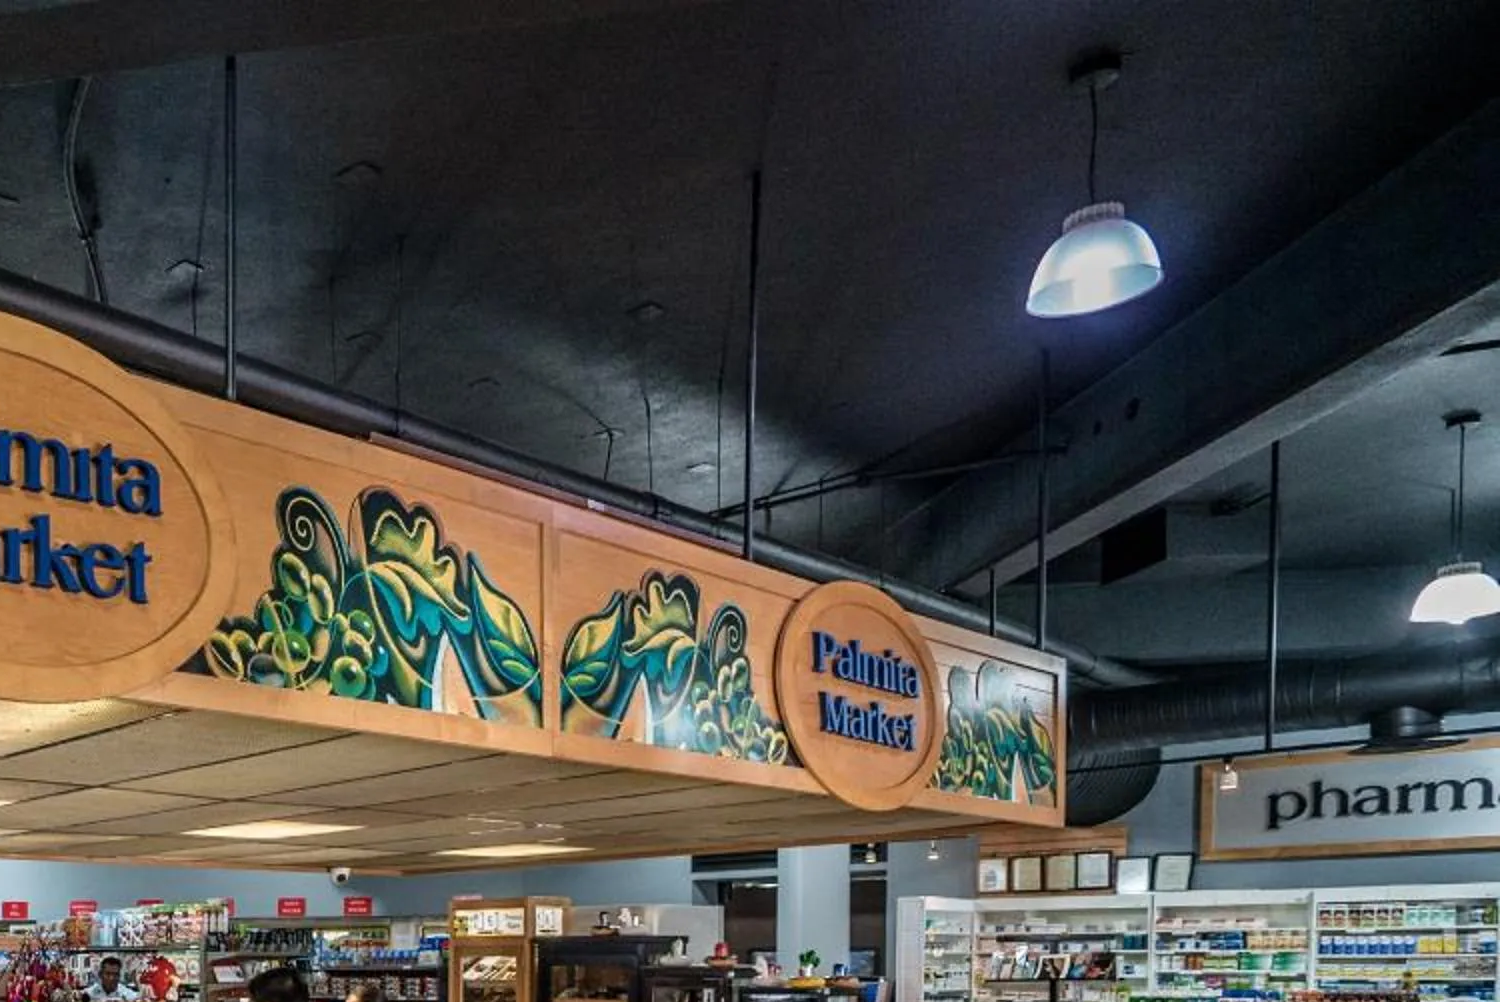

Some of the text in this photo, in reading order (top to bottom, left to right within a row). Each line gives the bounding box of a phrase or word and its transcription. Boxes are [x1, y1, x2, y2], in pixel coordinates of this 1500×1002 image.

[811, 630, 919, 699] Palmita
[817, 691, 916, 752] Market
[1266, 777, 1500, 831] pharm
